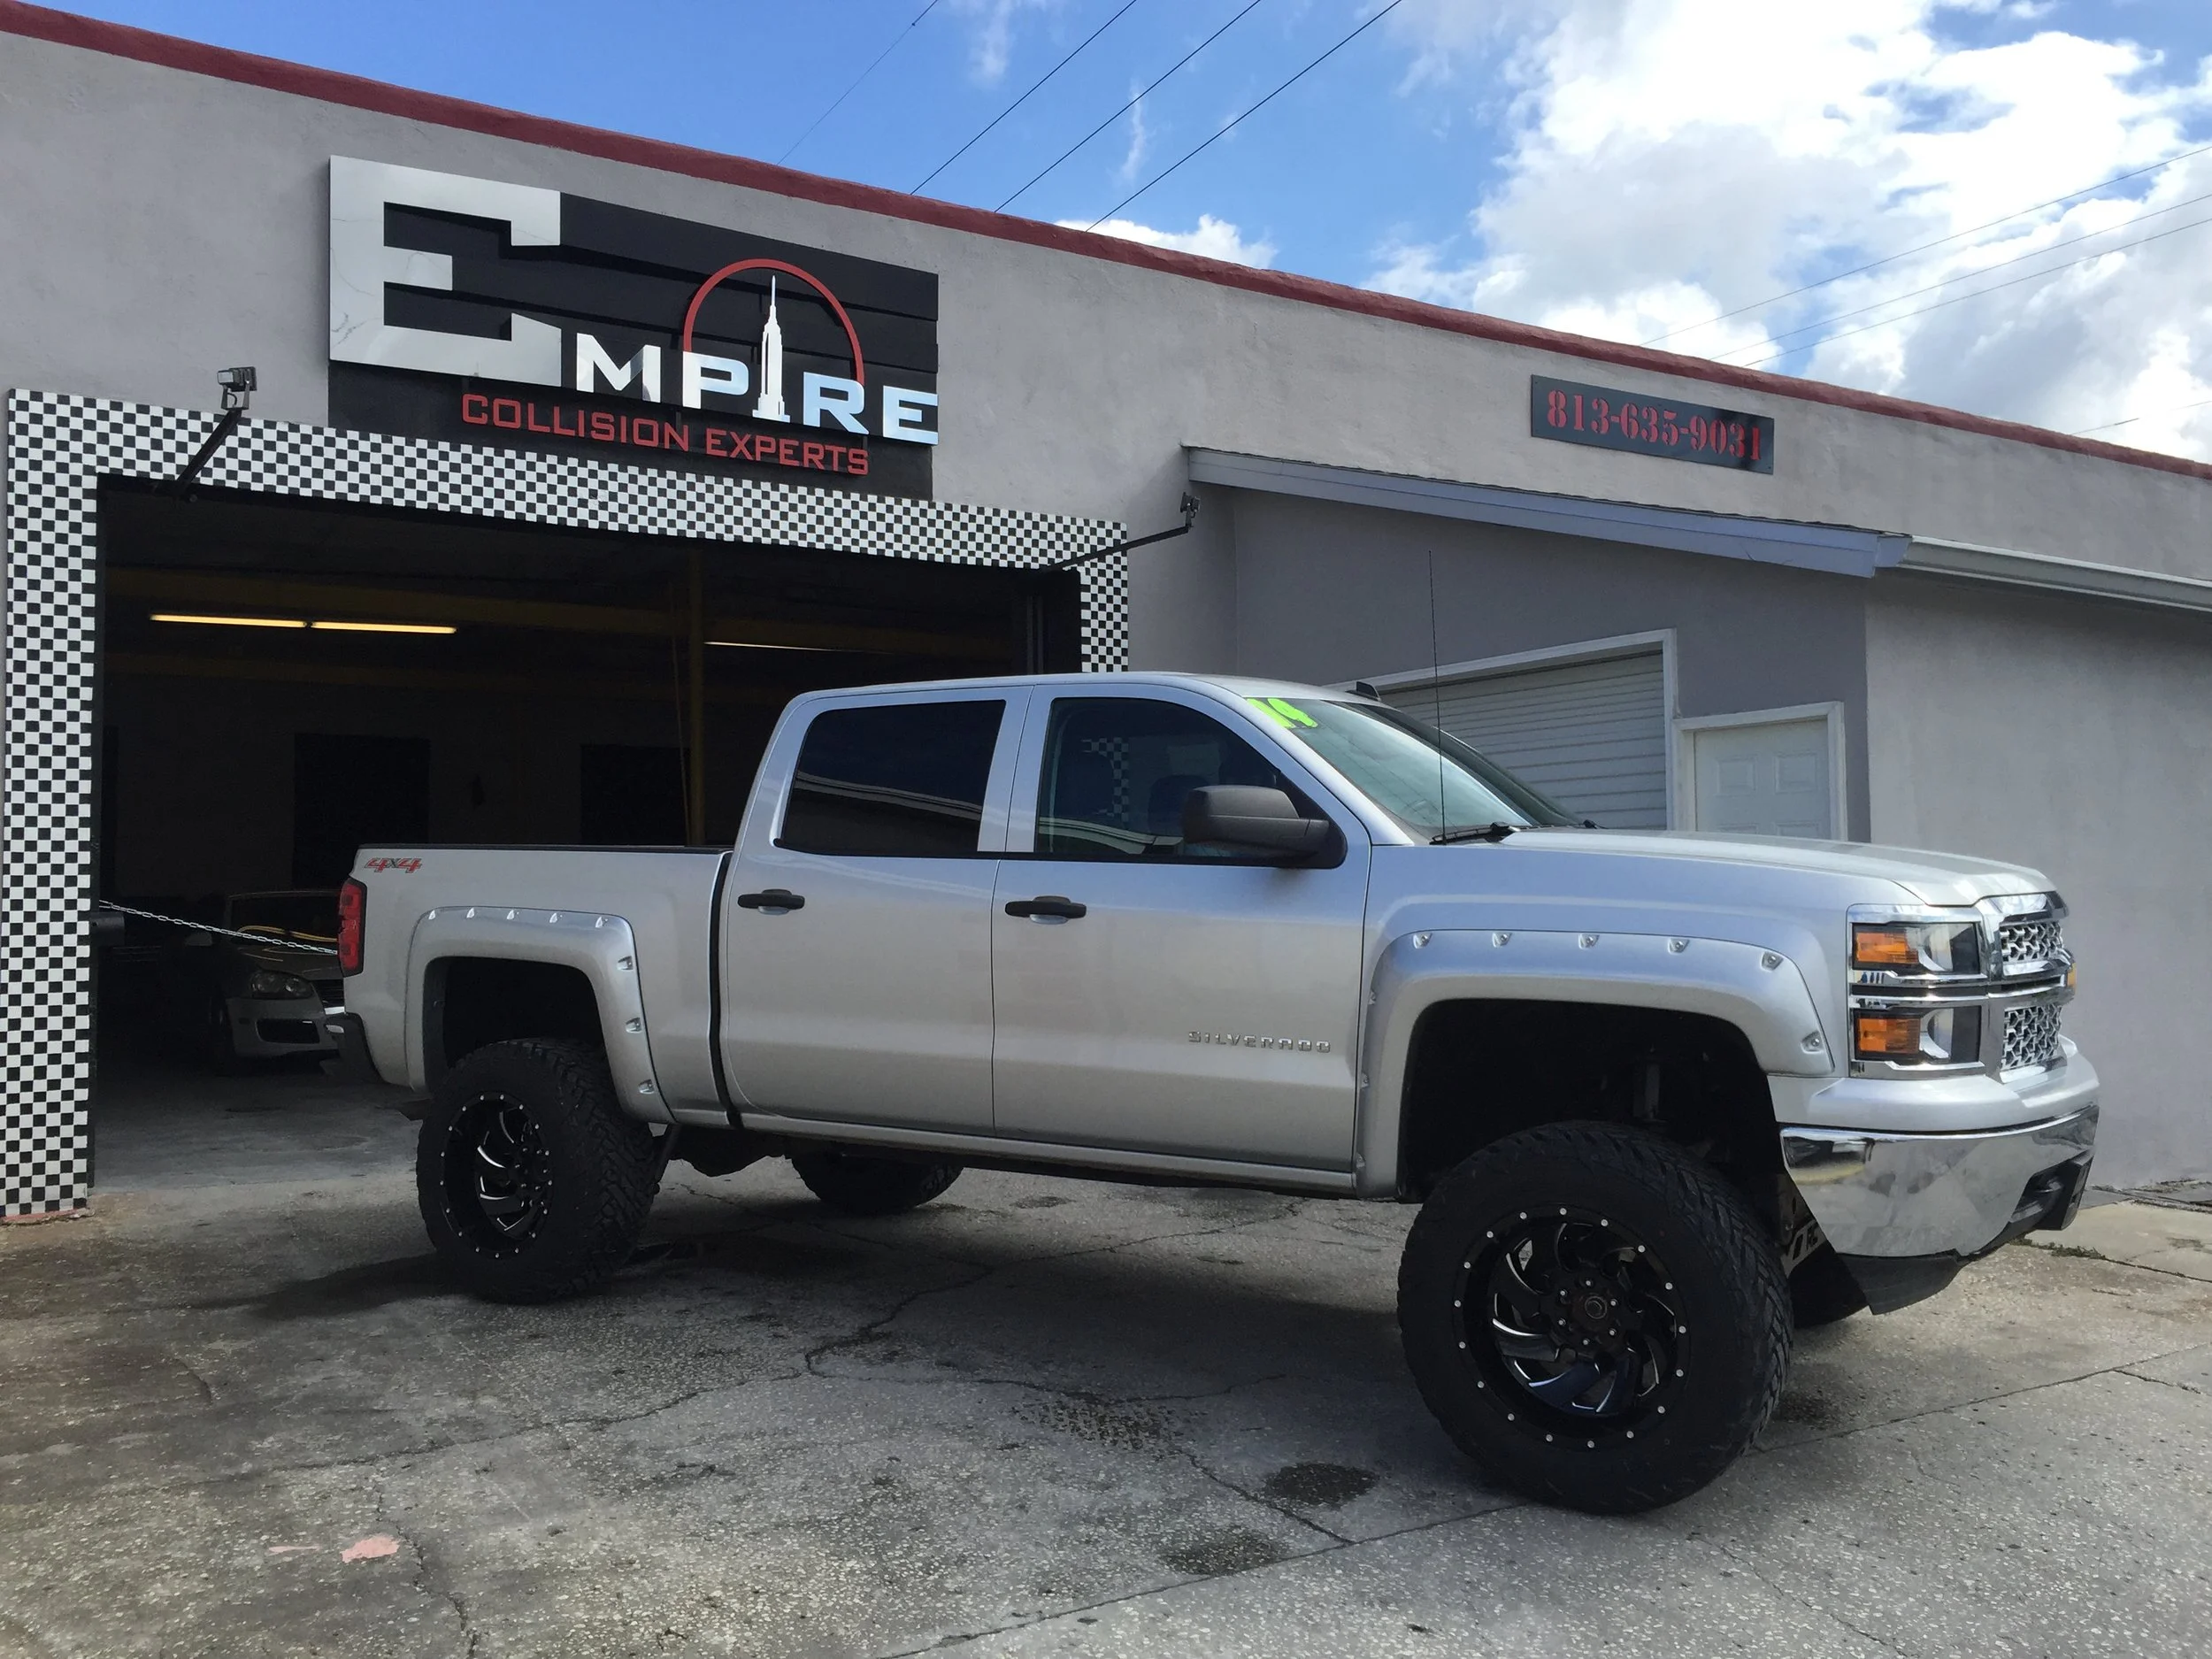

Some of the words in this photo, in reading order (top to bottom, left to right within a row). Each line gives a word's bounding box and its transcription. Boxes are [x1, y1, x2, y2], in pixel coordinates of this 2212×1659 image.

[461, 393, 690, 452] COLLISION
[705, 427, 871, 475] EXPERTS
[1548, 389, 1762, 461] 813-635-9031
[1188, 1031, 1331, 1053] SILVERADO
